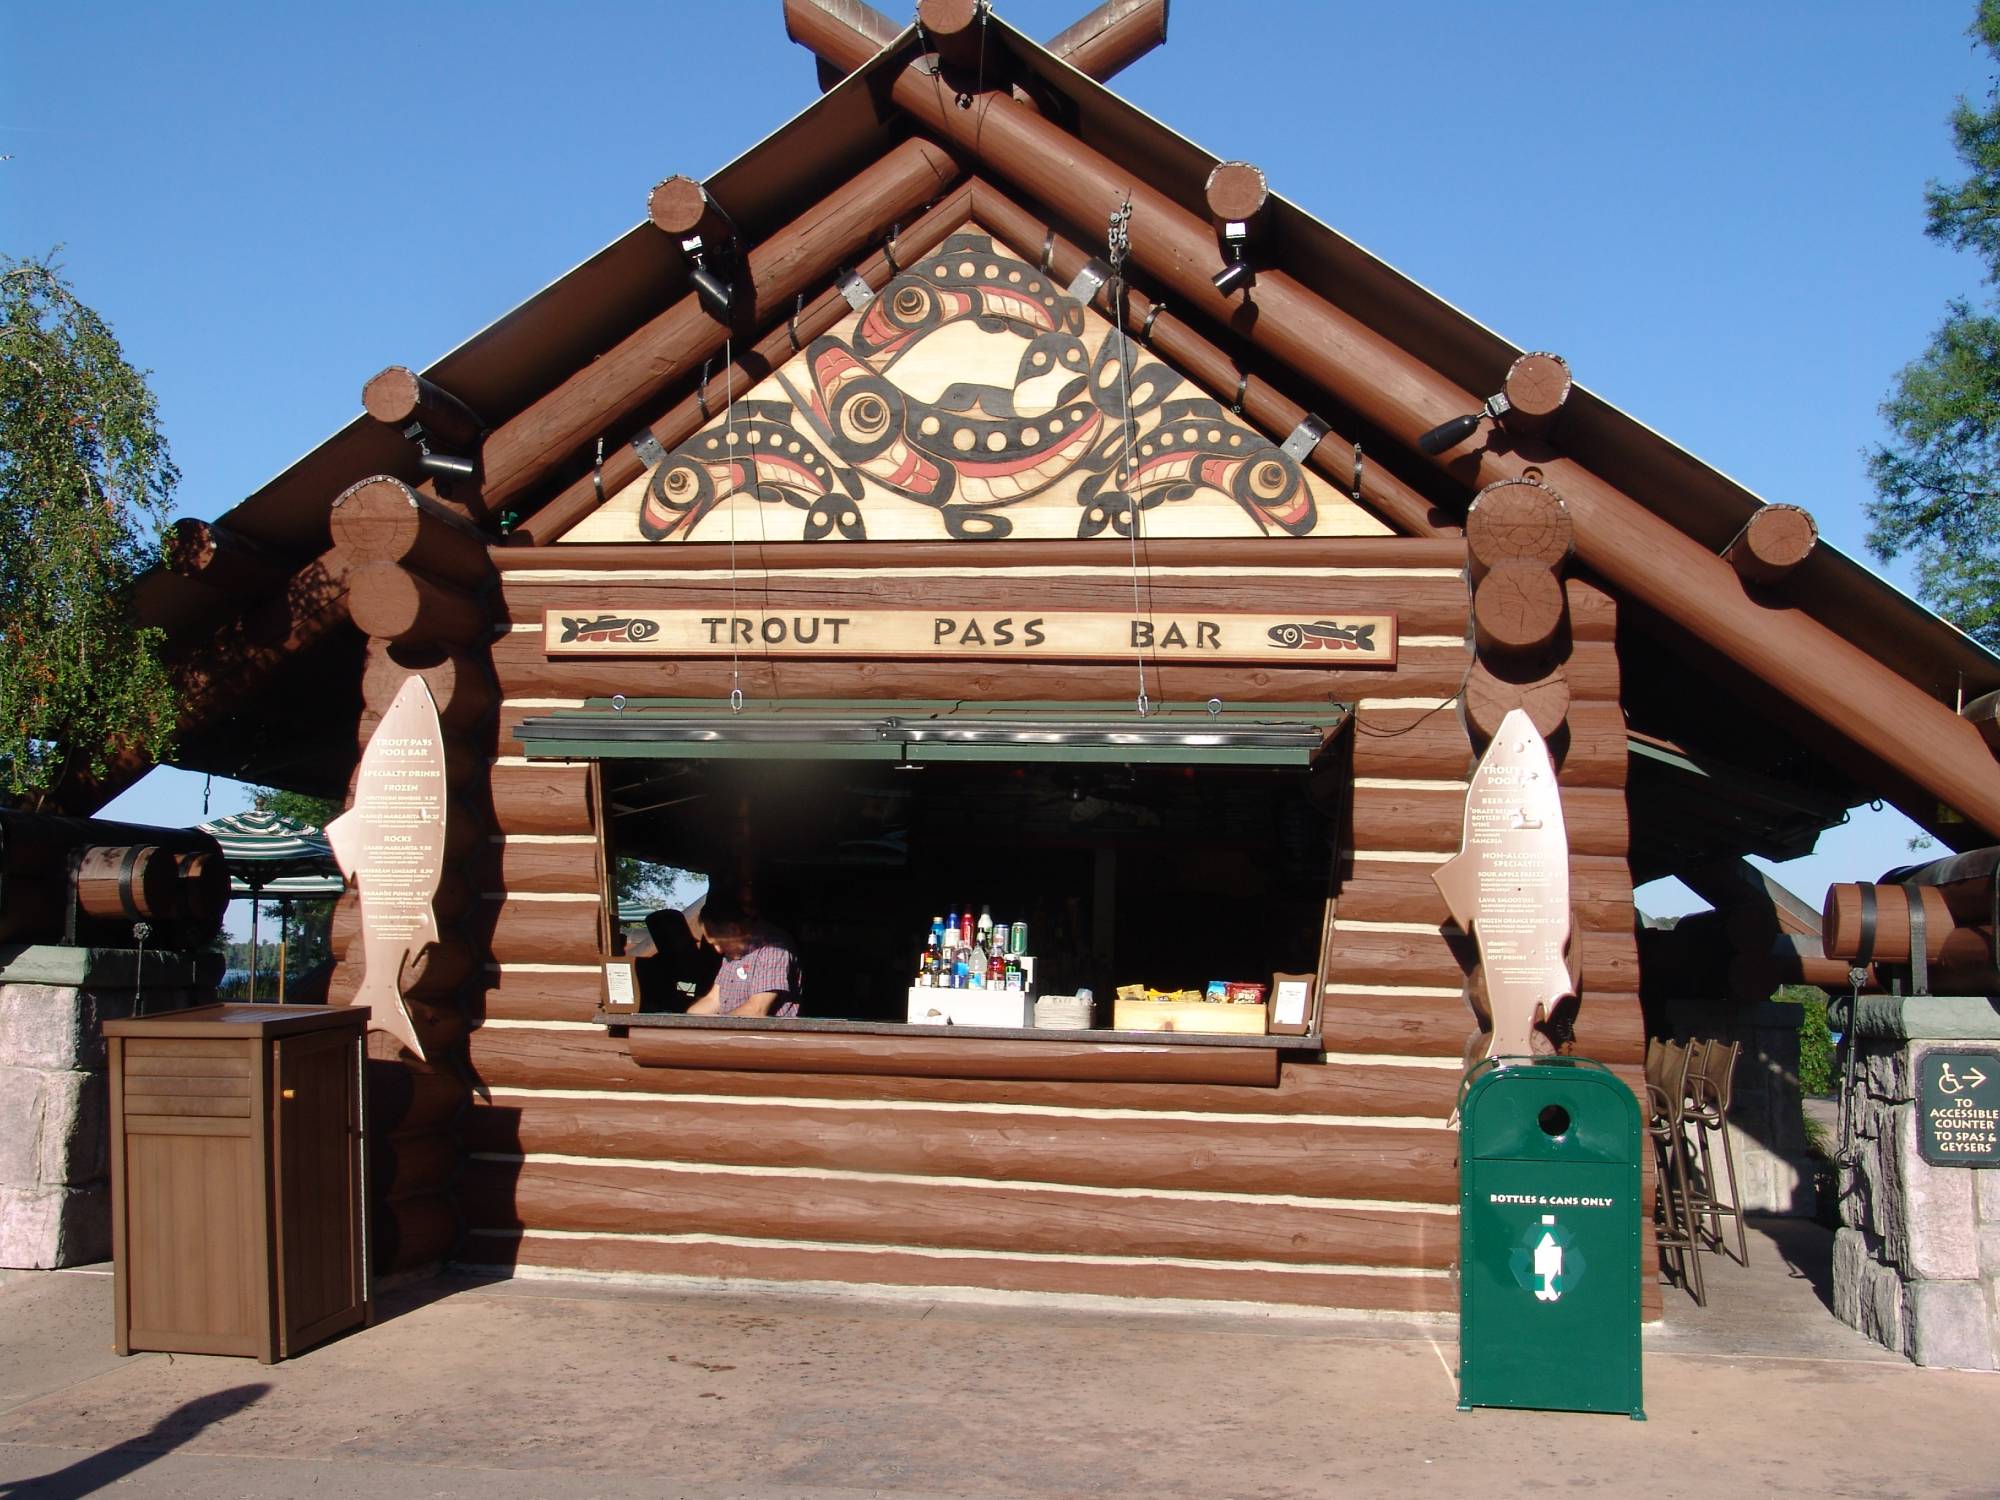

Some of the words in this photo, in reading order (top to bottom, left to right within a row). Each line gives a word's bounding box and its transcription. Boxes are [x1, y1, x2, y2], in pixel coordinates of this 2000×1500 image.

[701, 617, 850, 644] TROUT
[934, 618, 1046, 647] PASS
[1131, 620, 1222, 650] BAR
[376, 738, 409, 747] TROUT
[410, 738, 433, 747] PASS
[380, 748, 407, 756] POOL
[408, 748, 428, 756] BAR
[1482, 766, 1520, 774] TROUT
[1955, 1098, 1973, 1108] TO
[1930, 1108, 1999, 1119] ACCESSIBLE
[1935, 1119, 1995, 1129] COUNTER
[1934, 1131, 1953, 1141] TO
[1955, 1132, 1985, 1141] SPAS
[1987, 1133, 1997, 1142] &
[1940, 1142, 1992, 1153] GEYSERS
[1490, 1194, 1537, 1204] BOTTLES
[1539, 1195, 1547, 1205] &
[1549, 1196, 1579, 1206] CANS
[1581, 1197, 1613, 1207] ONLY
